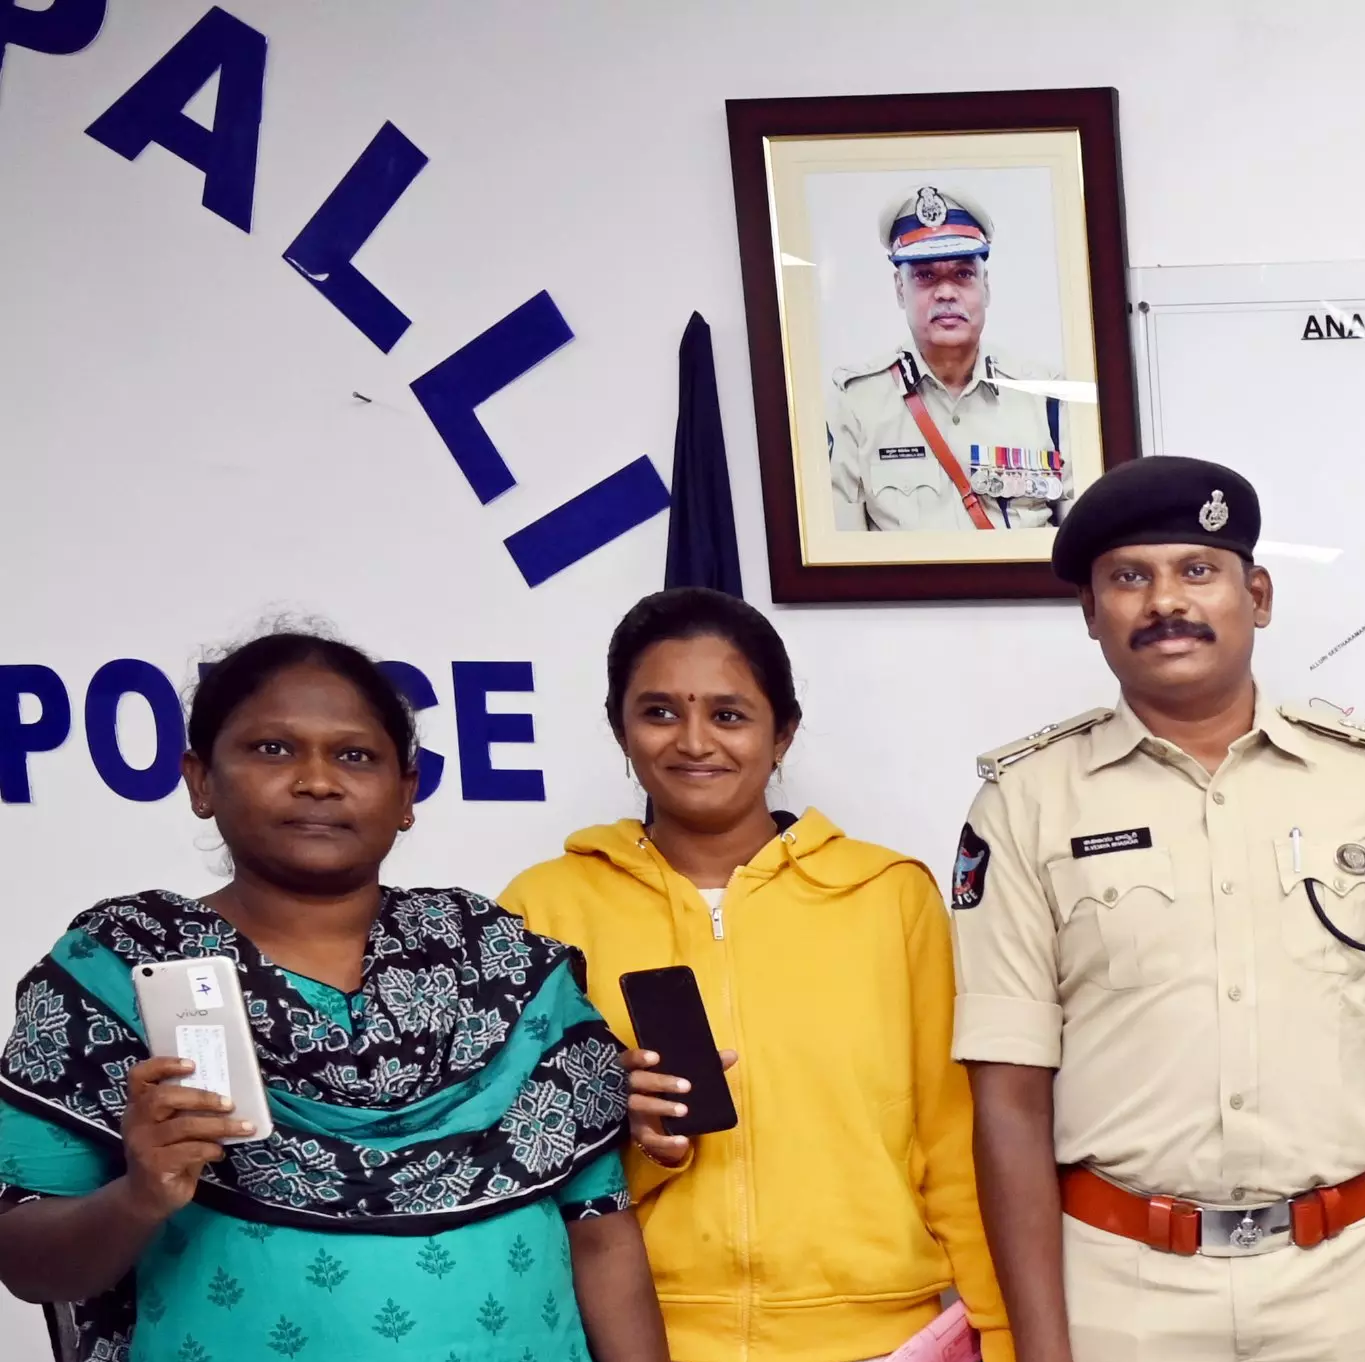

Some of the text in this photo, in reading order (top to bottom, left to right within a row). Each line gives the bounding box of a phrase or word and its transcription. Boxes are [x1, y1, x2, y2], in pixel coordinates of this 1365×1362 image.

[0, 659, 546, 803] POE
[195, 975, 212, 996] 14
[175, 1008, 209, 1020] vivo
